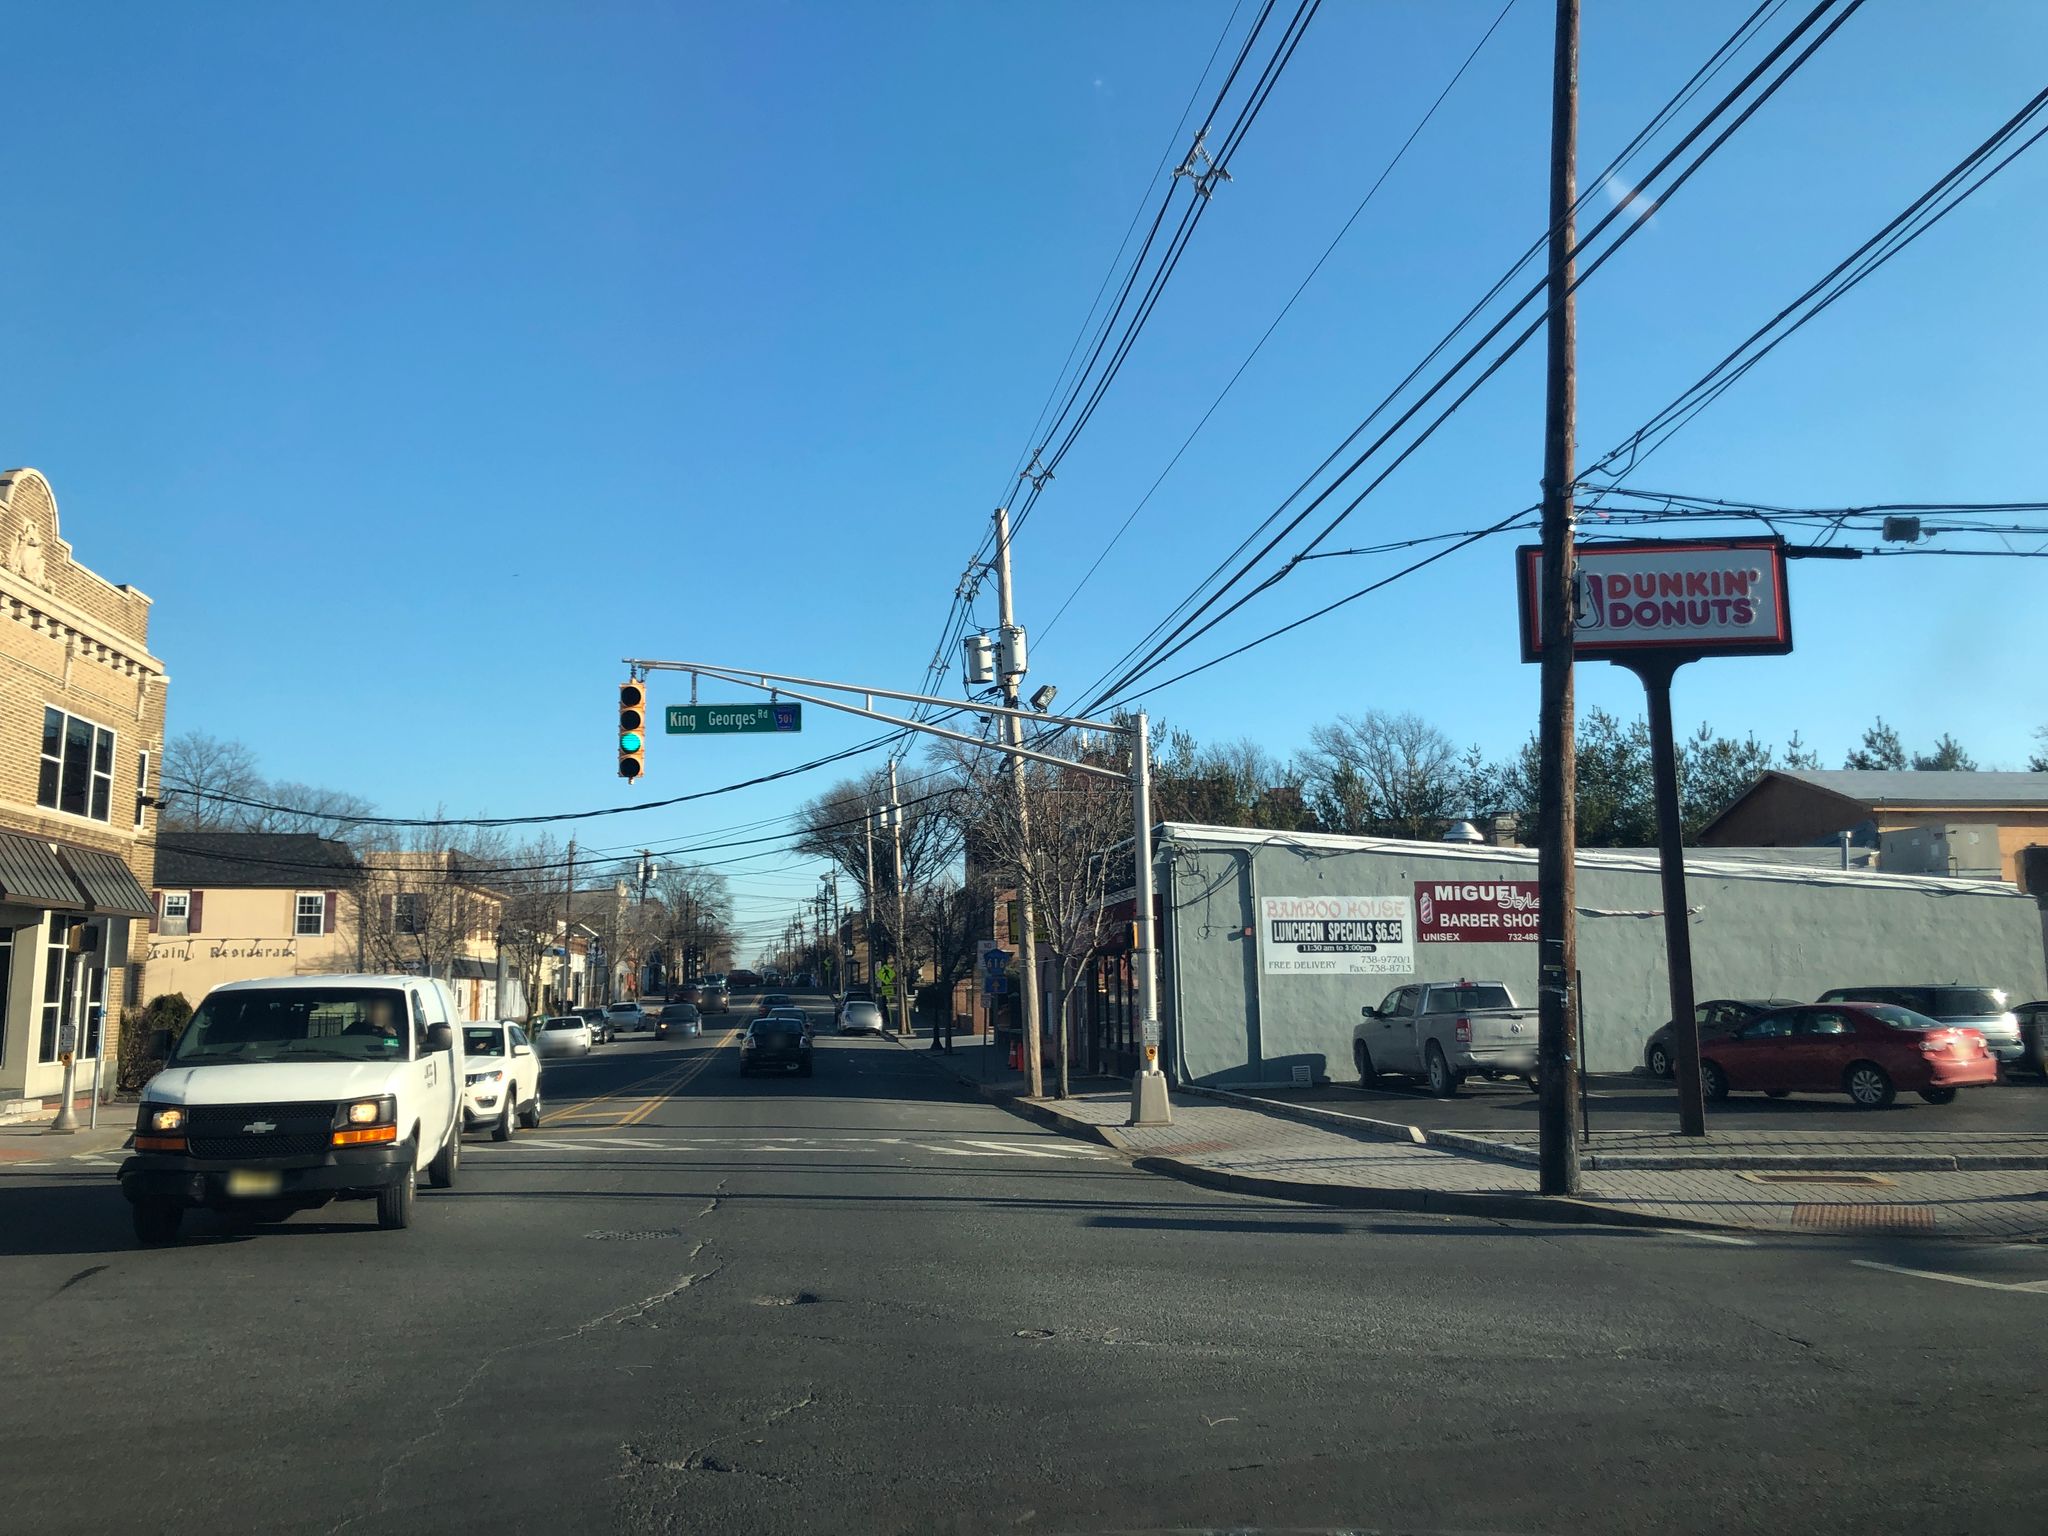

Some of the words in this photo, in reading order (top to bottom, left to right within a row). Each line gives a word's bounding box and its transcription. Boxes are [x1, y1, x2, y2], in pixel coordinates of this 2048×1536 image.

[1607, 570, 1758, 599] DUNKIN'
[1609, 599, 1755, 627] DONUTS
[670, 711, 696, 730] King
[708, 710, 756, 729] Georges
[758, 709, 768, 719] Rd
[778, 714, 792, 724] 501
[1267, 900, 1341, 918] BAMBOO
[1347, 901, 1406, 918] HOUSE
[1440, 913, 1499, 927] BARBER
[1273, 922, 1324, 941] LUNCHEON
[1328, 921, 1373, 941] SPECIALS
[1375, 921, 1402, 942] $6.95
[1423, 932, 1460, 941] UNISEX
[1268, 961, 1291, 969] FREE
[1294, 961, 1337, 969] DELIVERY
